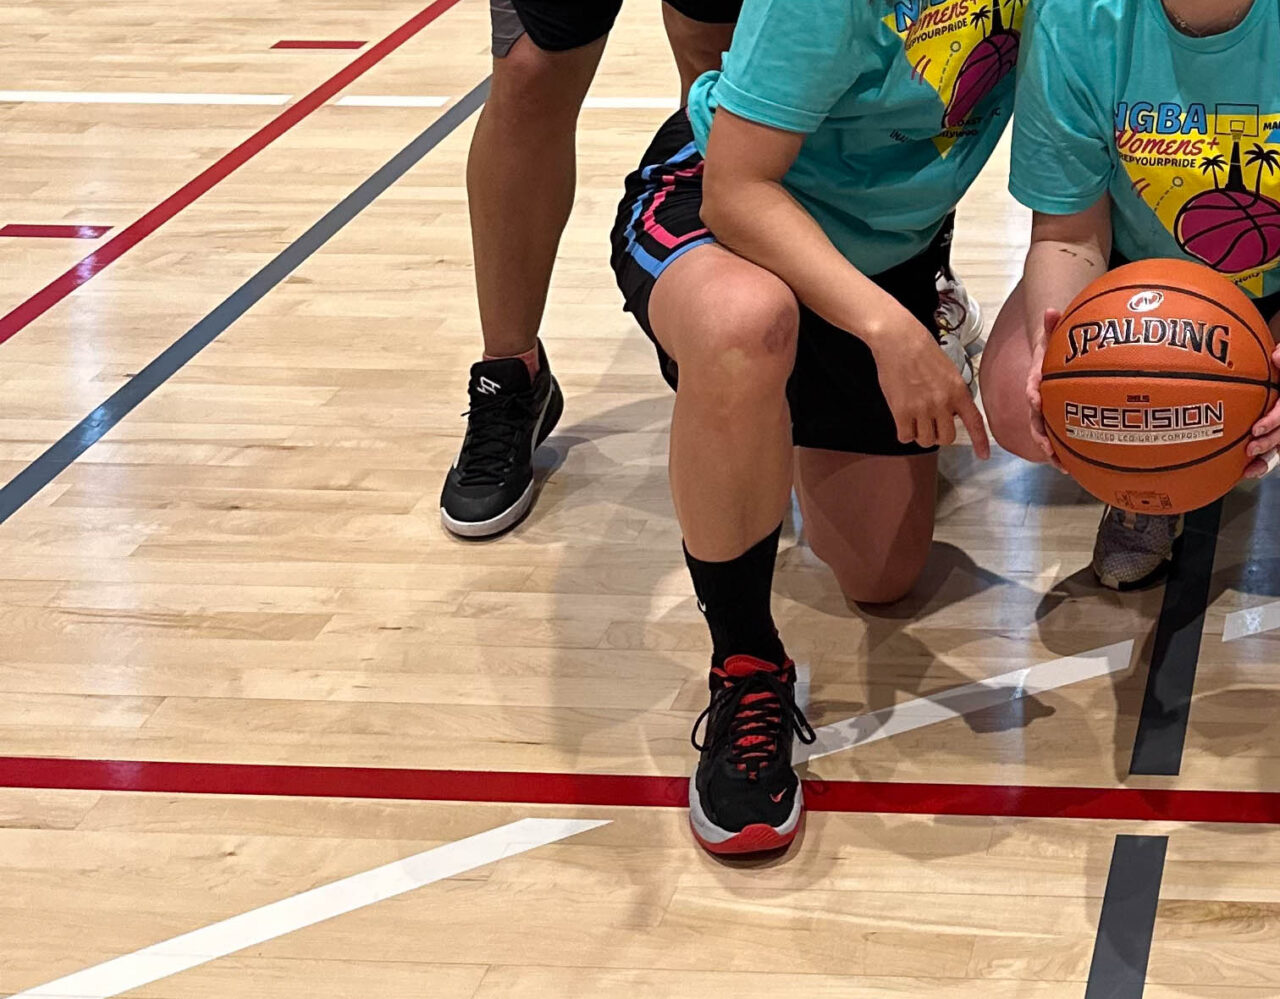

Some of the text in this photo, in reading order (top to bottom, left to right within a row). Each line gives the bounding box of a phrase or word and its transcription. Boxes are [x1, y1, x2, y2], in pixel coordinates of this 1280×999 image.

[1064, 317, 1232, 366] SPALDING
[1065, 400, 1224, 431] PRECISION
[1161, 430, 1210, 441] COMPOSITE
